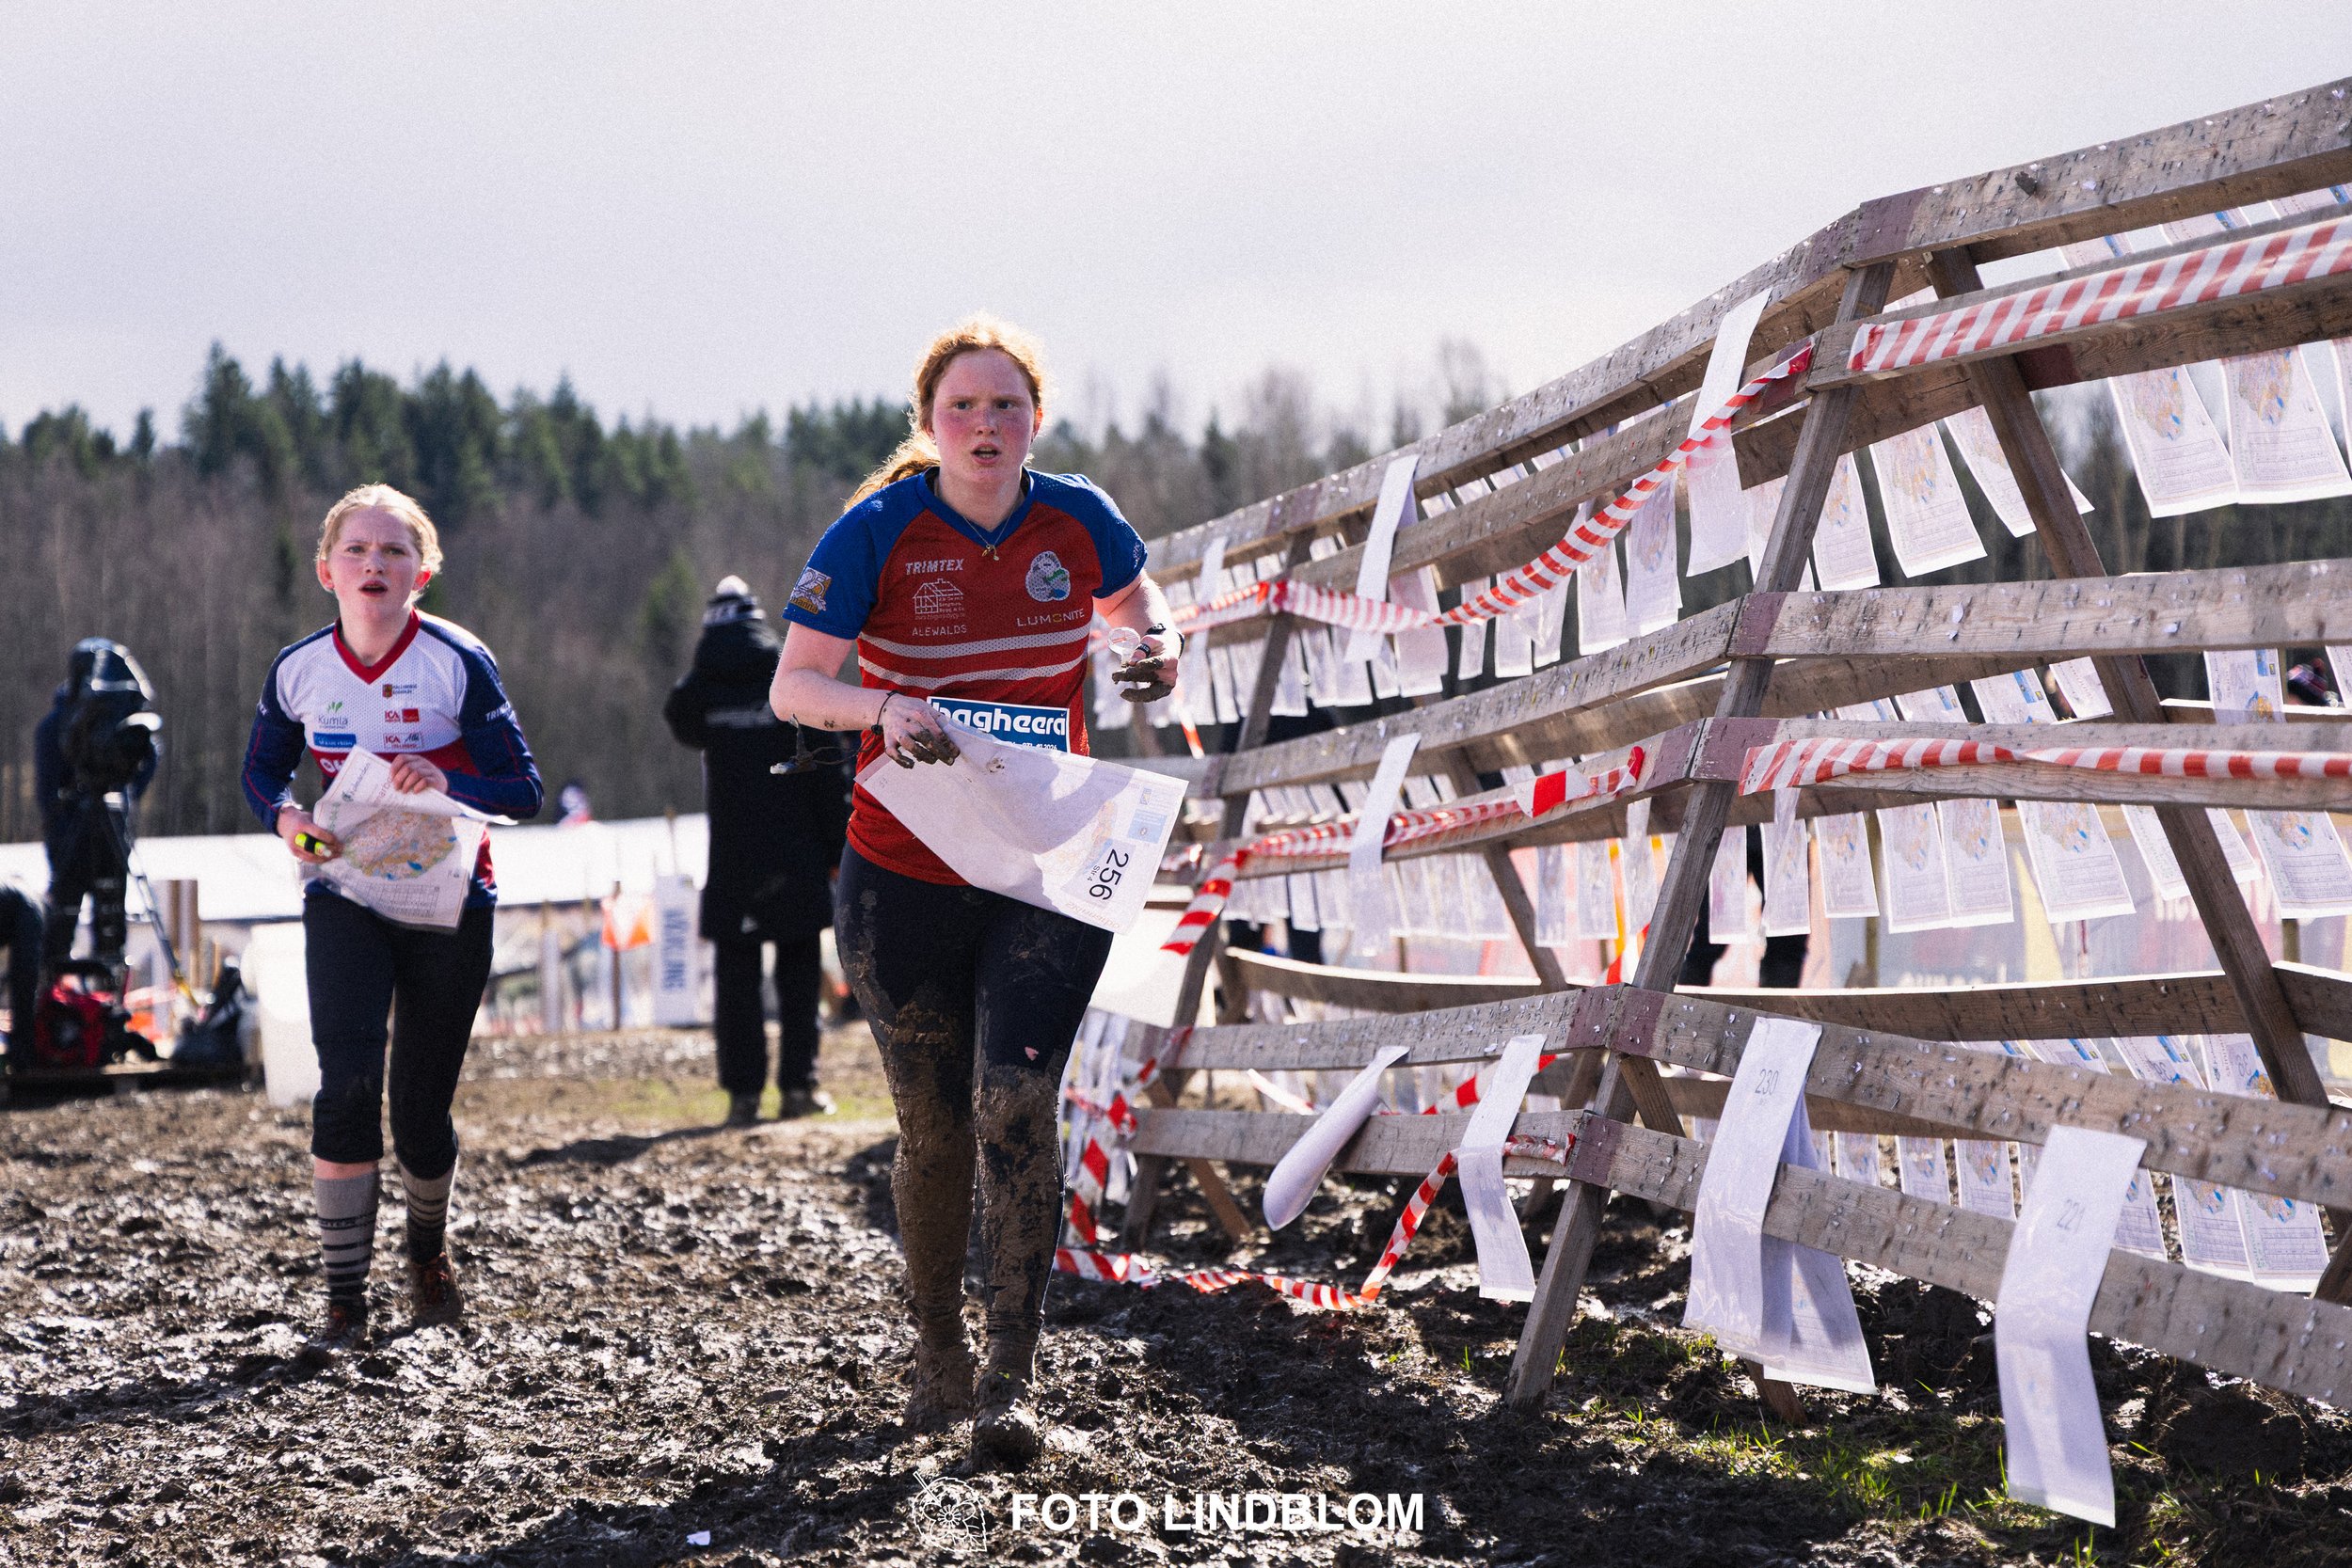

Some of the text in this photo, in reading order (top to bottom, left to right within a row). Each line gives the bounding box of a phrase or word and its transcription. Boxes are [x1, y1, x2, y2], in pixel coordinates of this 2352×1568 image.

[906, 559, 964, 575] TRIMTEX
[912, 624, 967, 637] ALEWALDS
[318, 715, 348, 725] Kumla
[385, 710, 400, 719] ICA
[1089, 848, 1129, 900] 256
